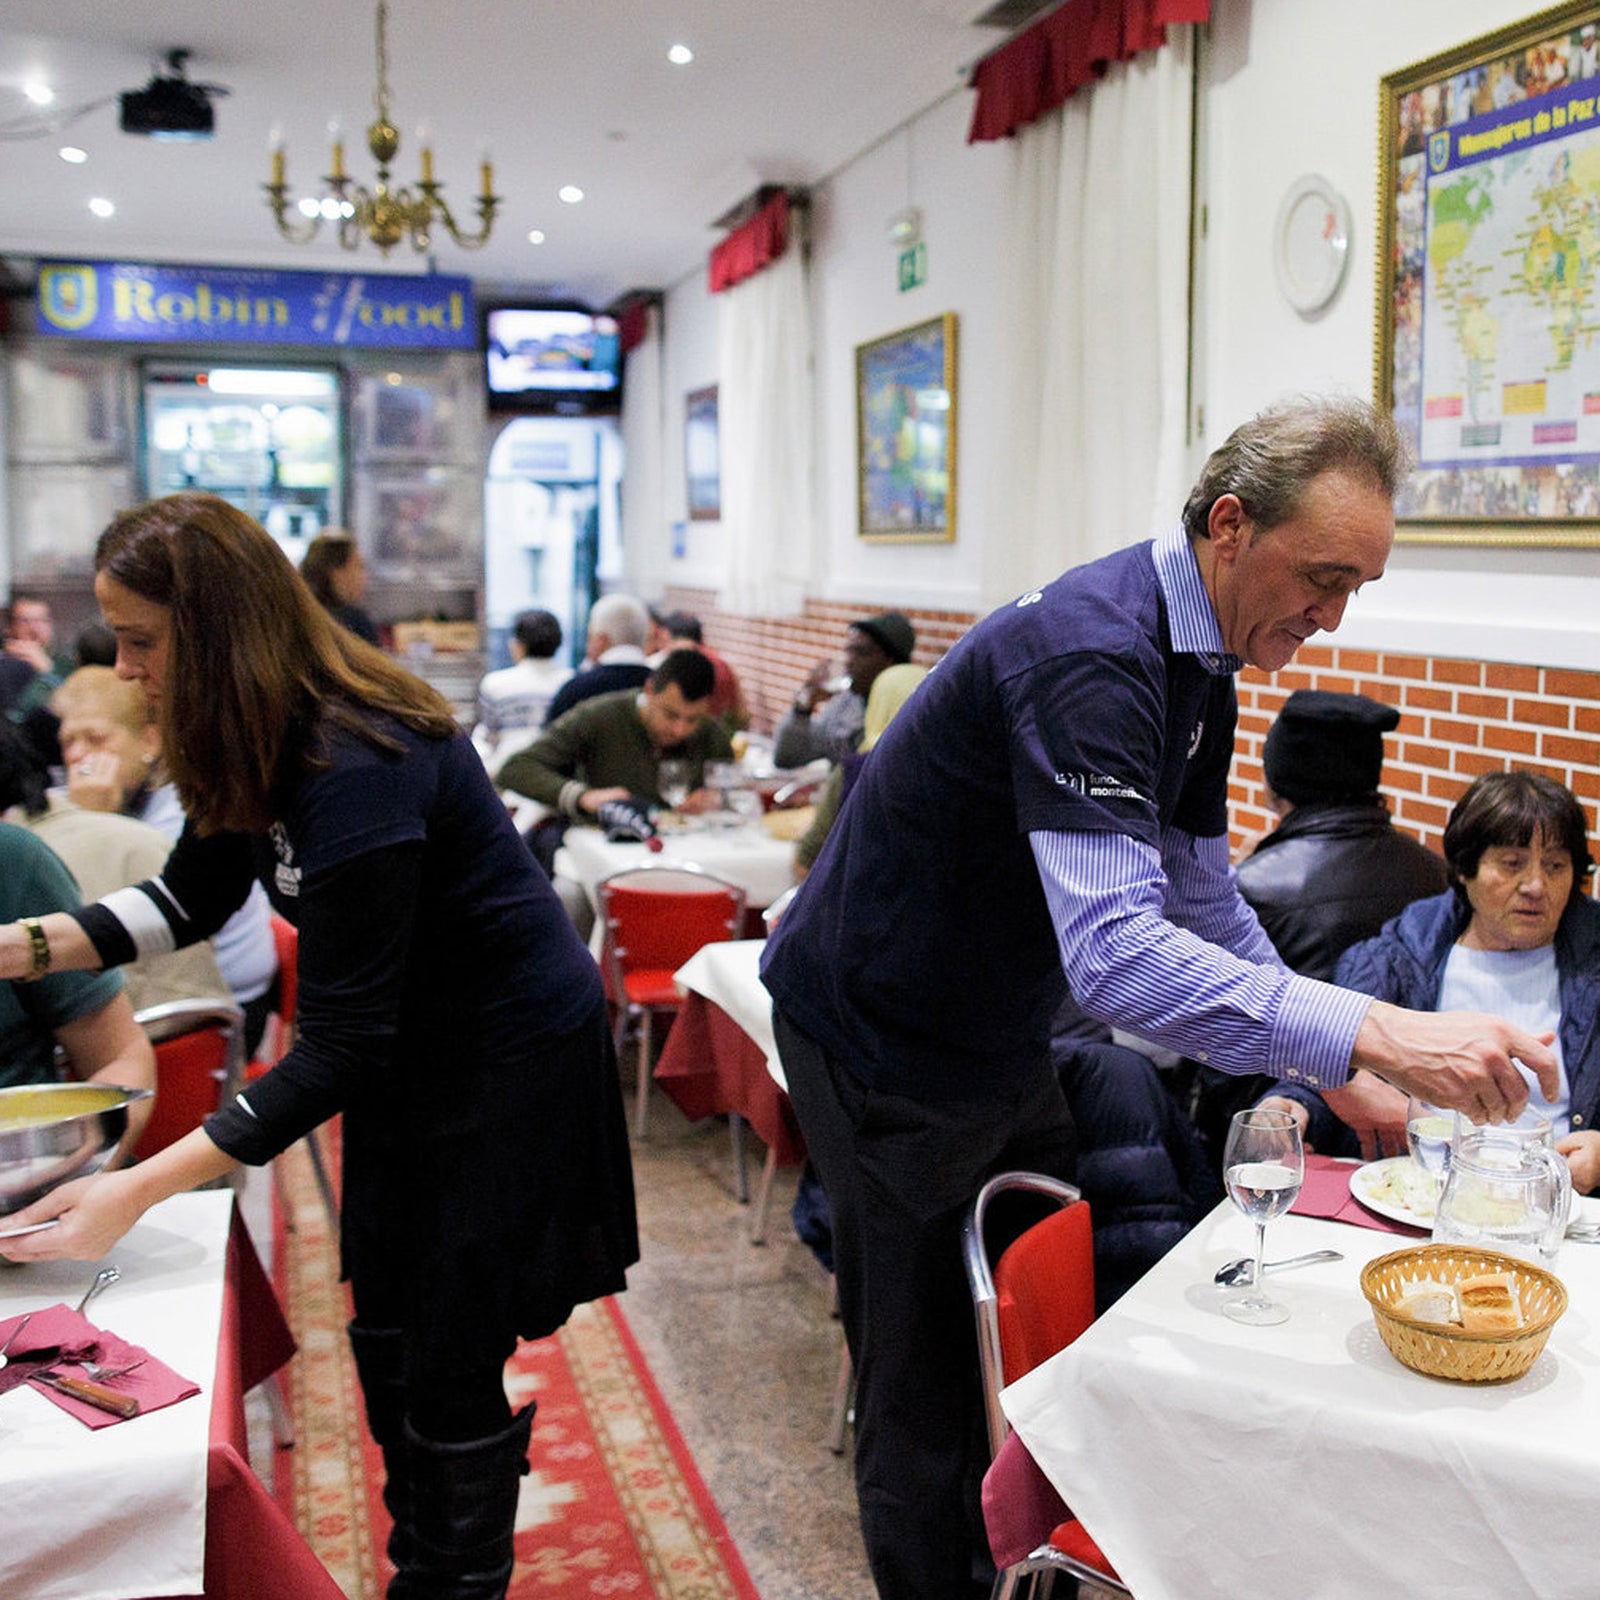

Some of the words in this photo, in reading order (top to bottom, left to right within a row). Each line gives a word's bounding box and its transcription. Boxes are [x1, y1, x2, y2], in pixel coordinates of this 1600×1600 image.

[1533, 111, 1551, 134] de
[1552, 107, 1566, 128] la
[1568, 97, 1595, 124] Paz
[113, 277, 289, 325] Robin
